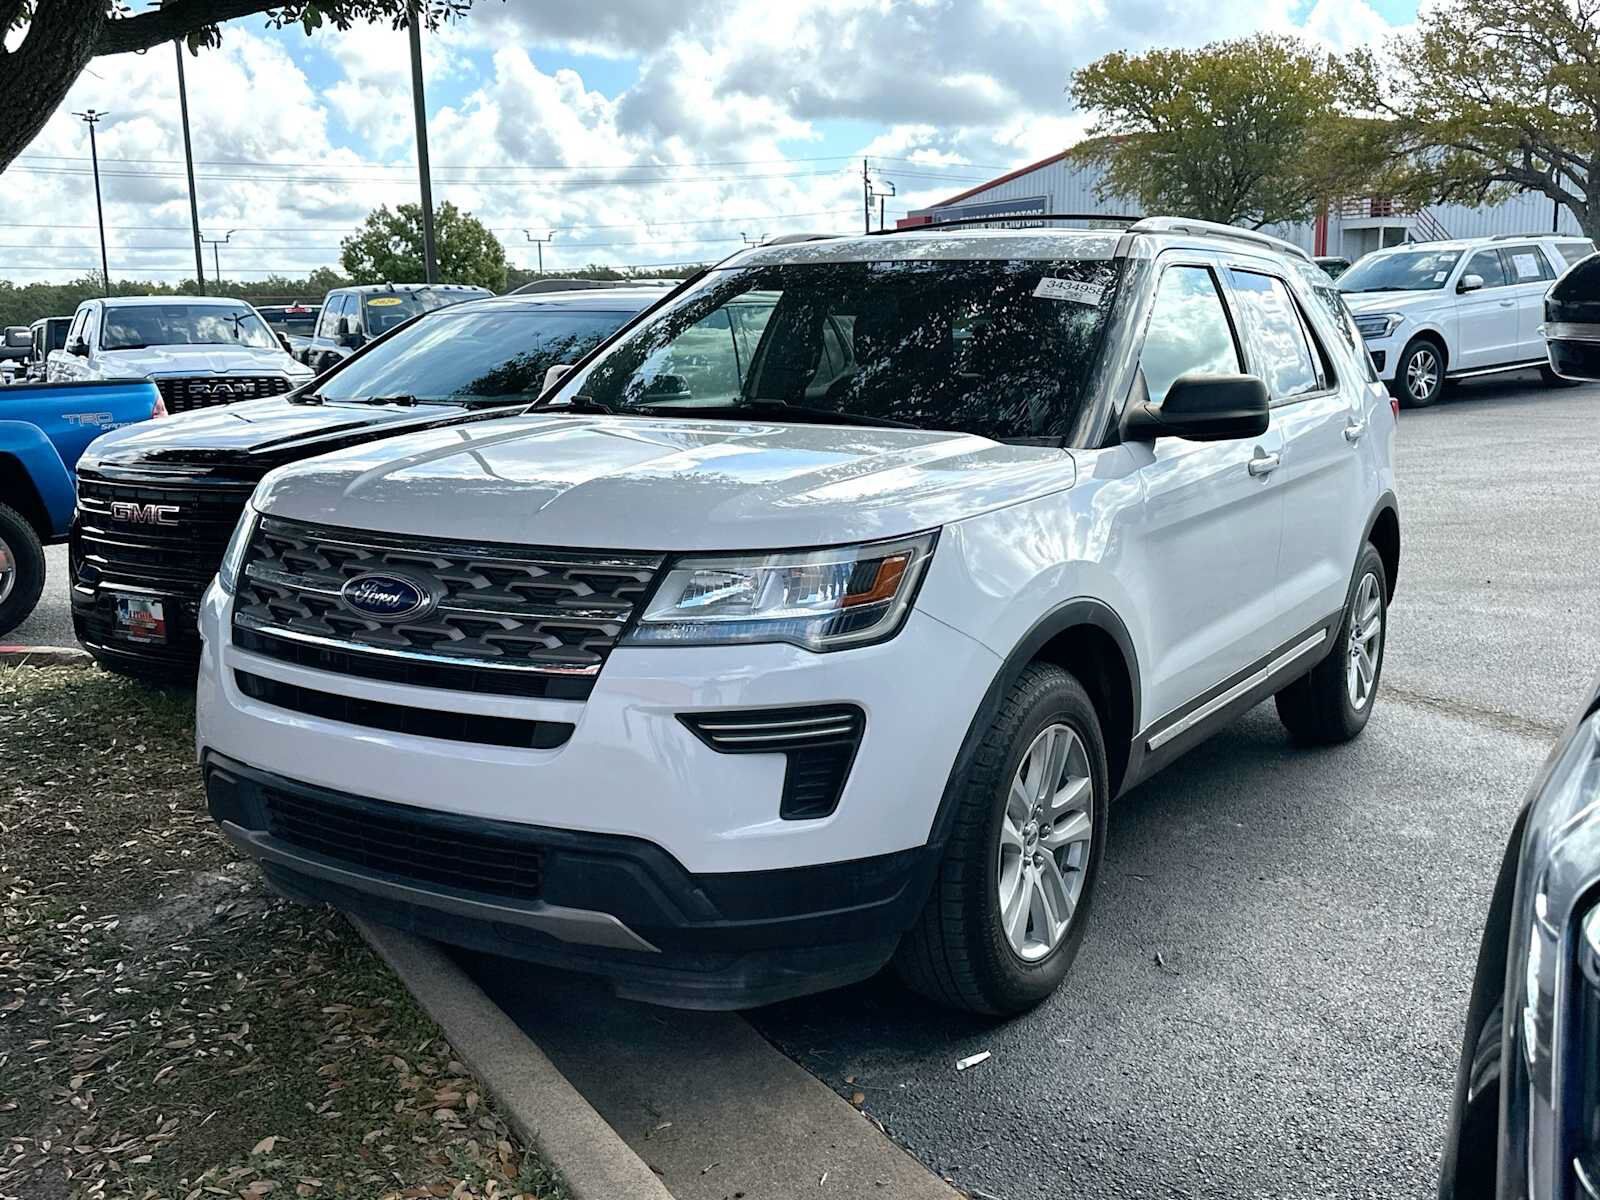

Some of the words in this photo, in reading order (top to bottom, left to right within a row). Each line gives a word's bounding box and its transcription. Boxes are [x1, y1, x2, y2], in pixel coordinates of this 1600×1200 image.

[188, 383, 256, 394] RAM
[61, 412, 113, 427] TRD
[110, 502, 180, 526] GMC
[354, 580, 405, 608] Ford
